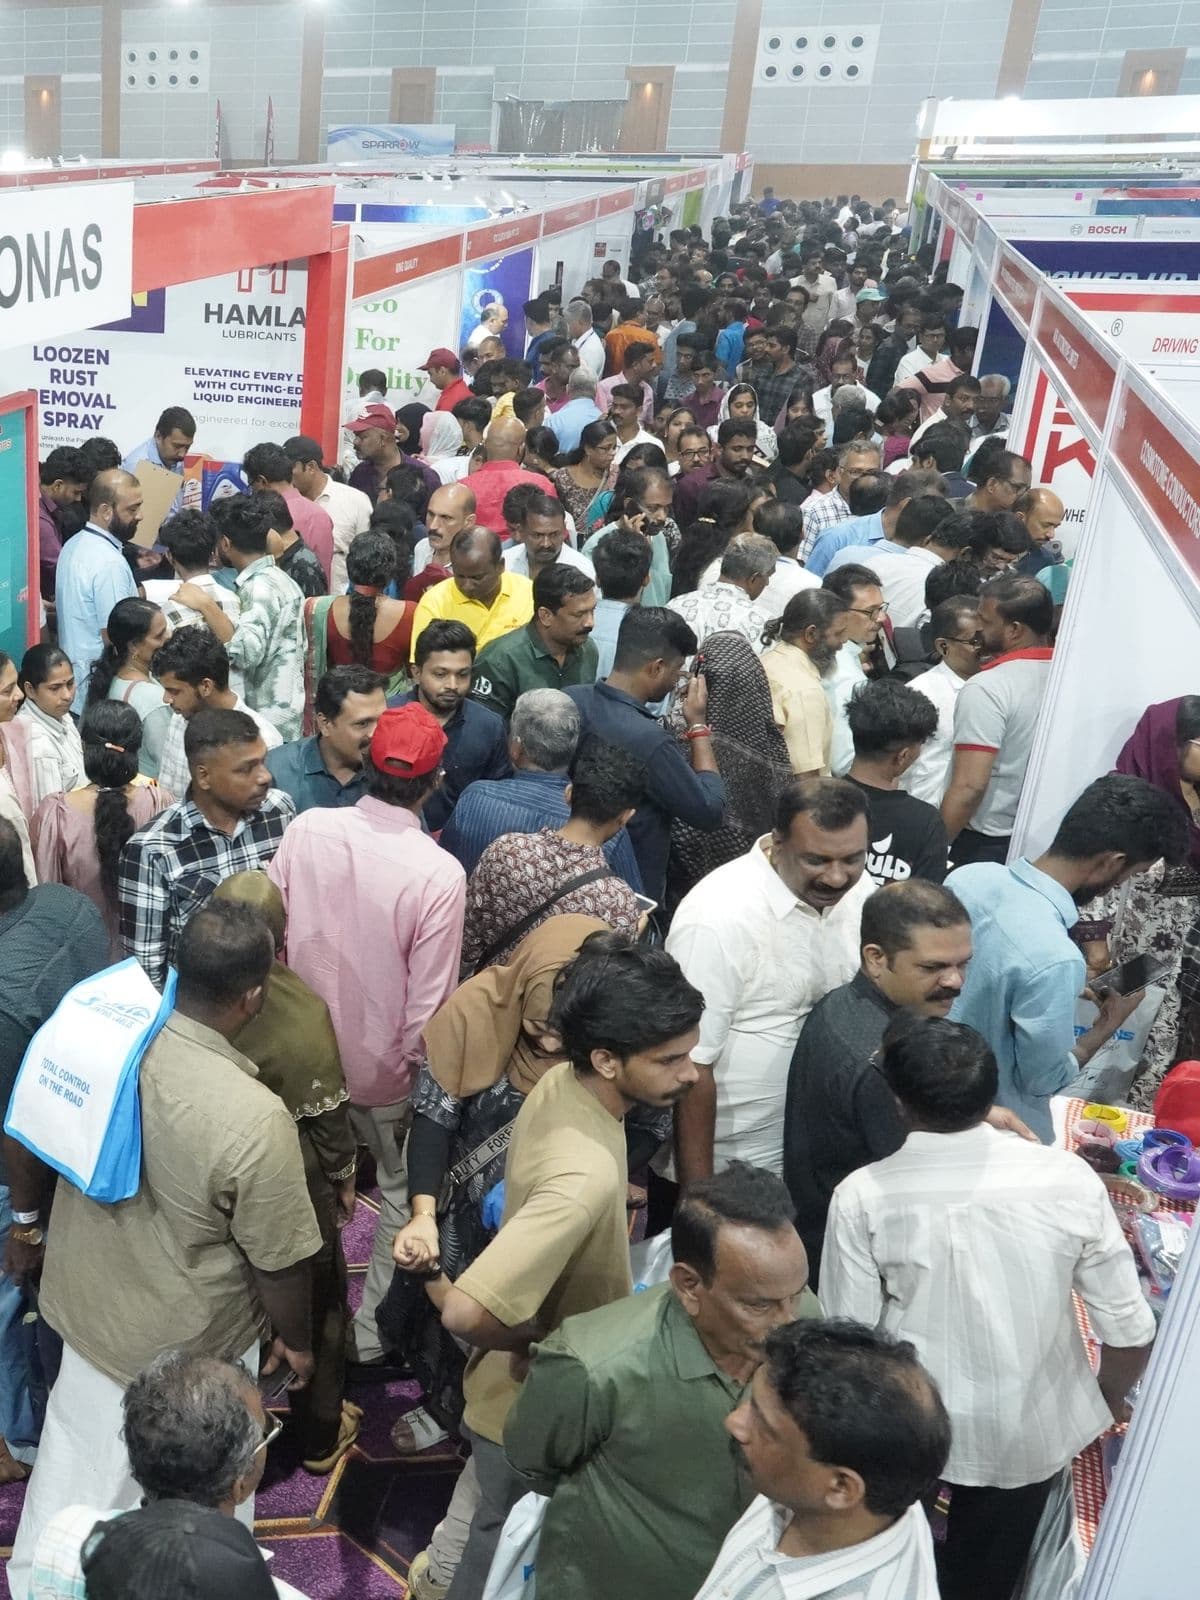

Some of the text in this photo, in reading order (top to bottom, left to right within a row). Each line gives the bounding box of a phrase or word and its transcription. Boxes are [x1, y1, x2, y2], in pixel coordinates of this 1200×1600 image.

[1088, 225, 1127, 234] BOSCH
[204, 303, 306, 328] HAMLA
[222, 330, 297, 342] LUBRICANTS
[355, 328, 400, 351] For
[1152, 338, 1199, 353] DRIVING
[33, 345, 110, 365] LOOZEN
[50, 368, 98, 386] RUST
[185, 367, 250, 379] ELEVATING
[254, 371, 294, 382] EVERY
[194, 380, 304, 395] WITH CUTTING-ED
[28, 388, 117, 410] EMOVAL
[193, 392, 302, 408] LIQUID ENGINEERI
[43, 411, 104, 430] SPRAY
[194, 414, 298, 429] ngineered for excel
[1061, 508, 1086, 523] WHE
[865, 851, 912, 880] ULD
[40, 1057, 91, 1095] TOTAL CONTROL
[39, 1074, 84, 1108] ON THE ROAD
[454, 1126, 514, 1179] AUTY FORE
